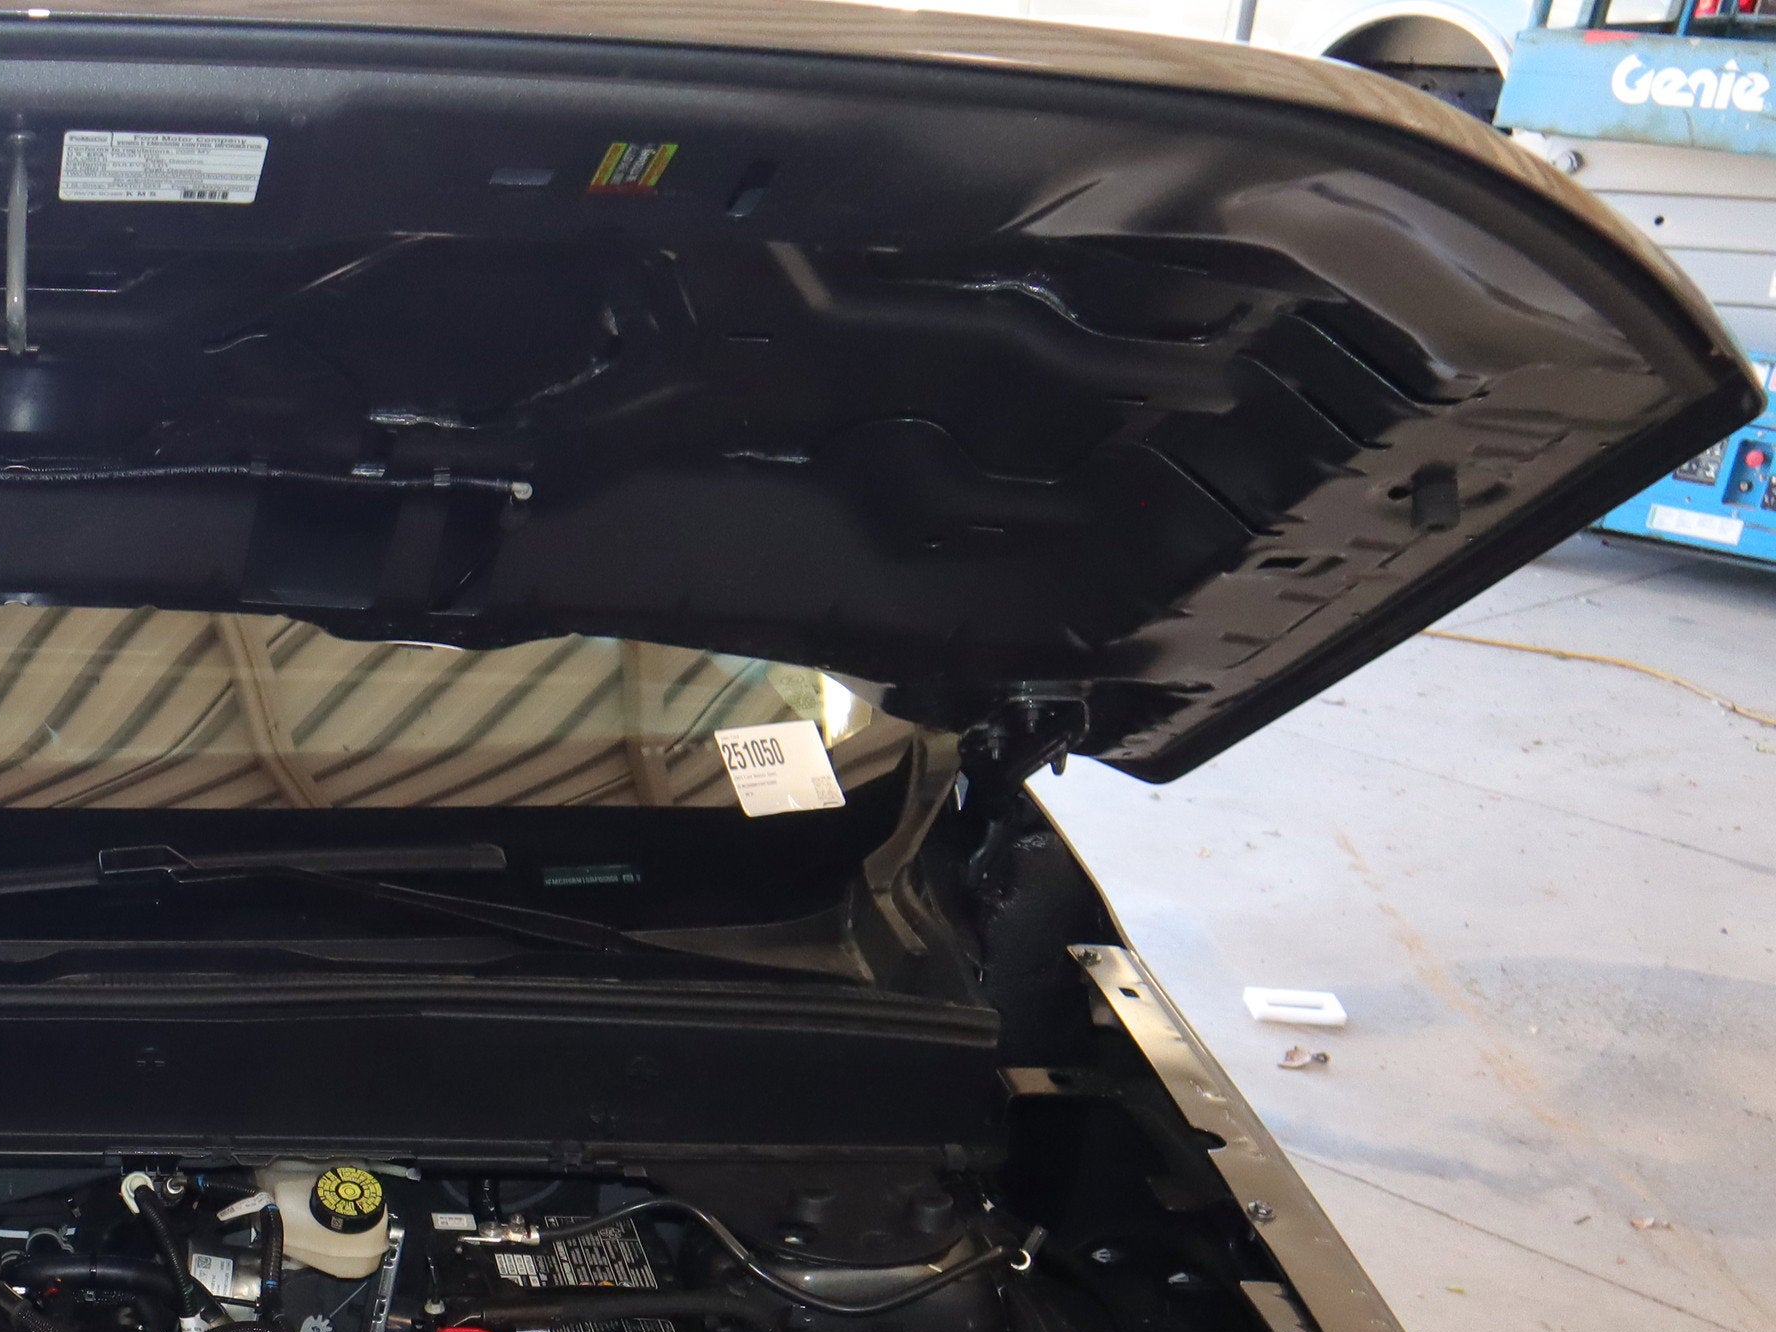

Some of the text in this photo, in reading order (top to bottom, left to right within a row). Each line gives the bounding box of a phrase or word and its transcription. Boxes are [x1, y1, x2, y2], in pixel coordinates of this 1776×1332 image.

[1611, 54, 1771, 112] Genie
[162, 135, 193, 143] Motor
[196, 137, 247, 145] Company
[721, 737, 785, 771] 251050
